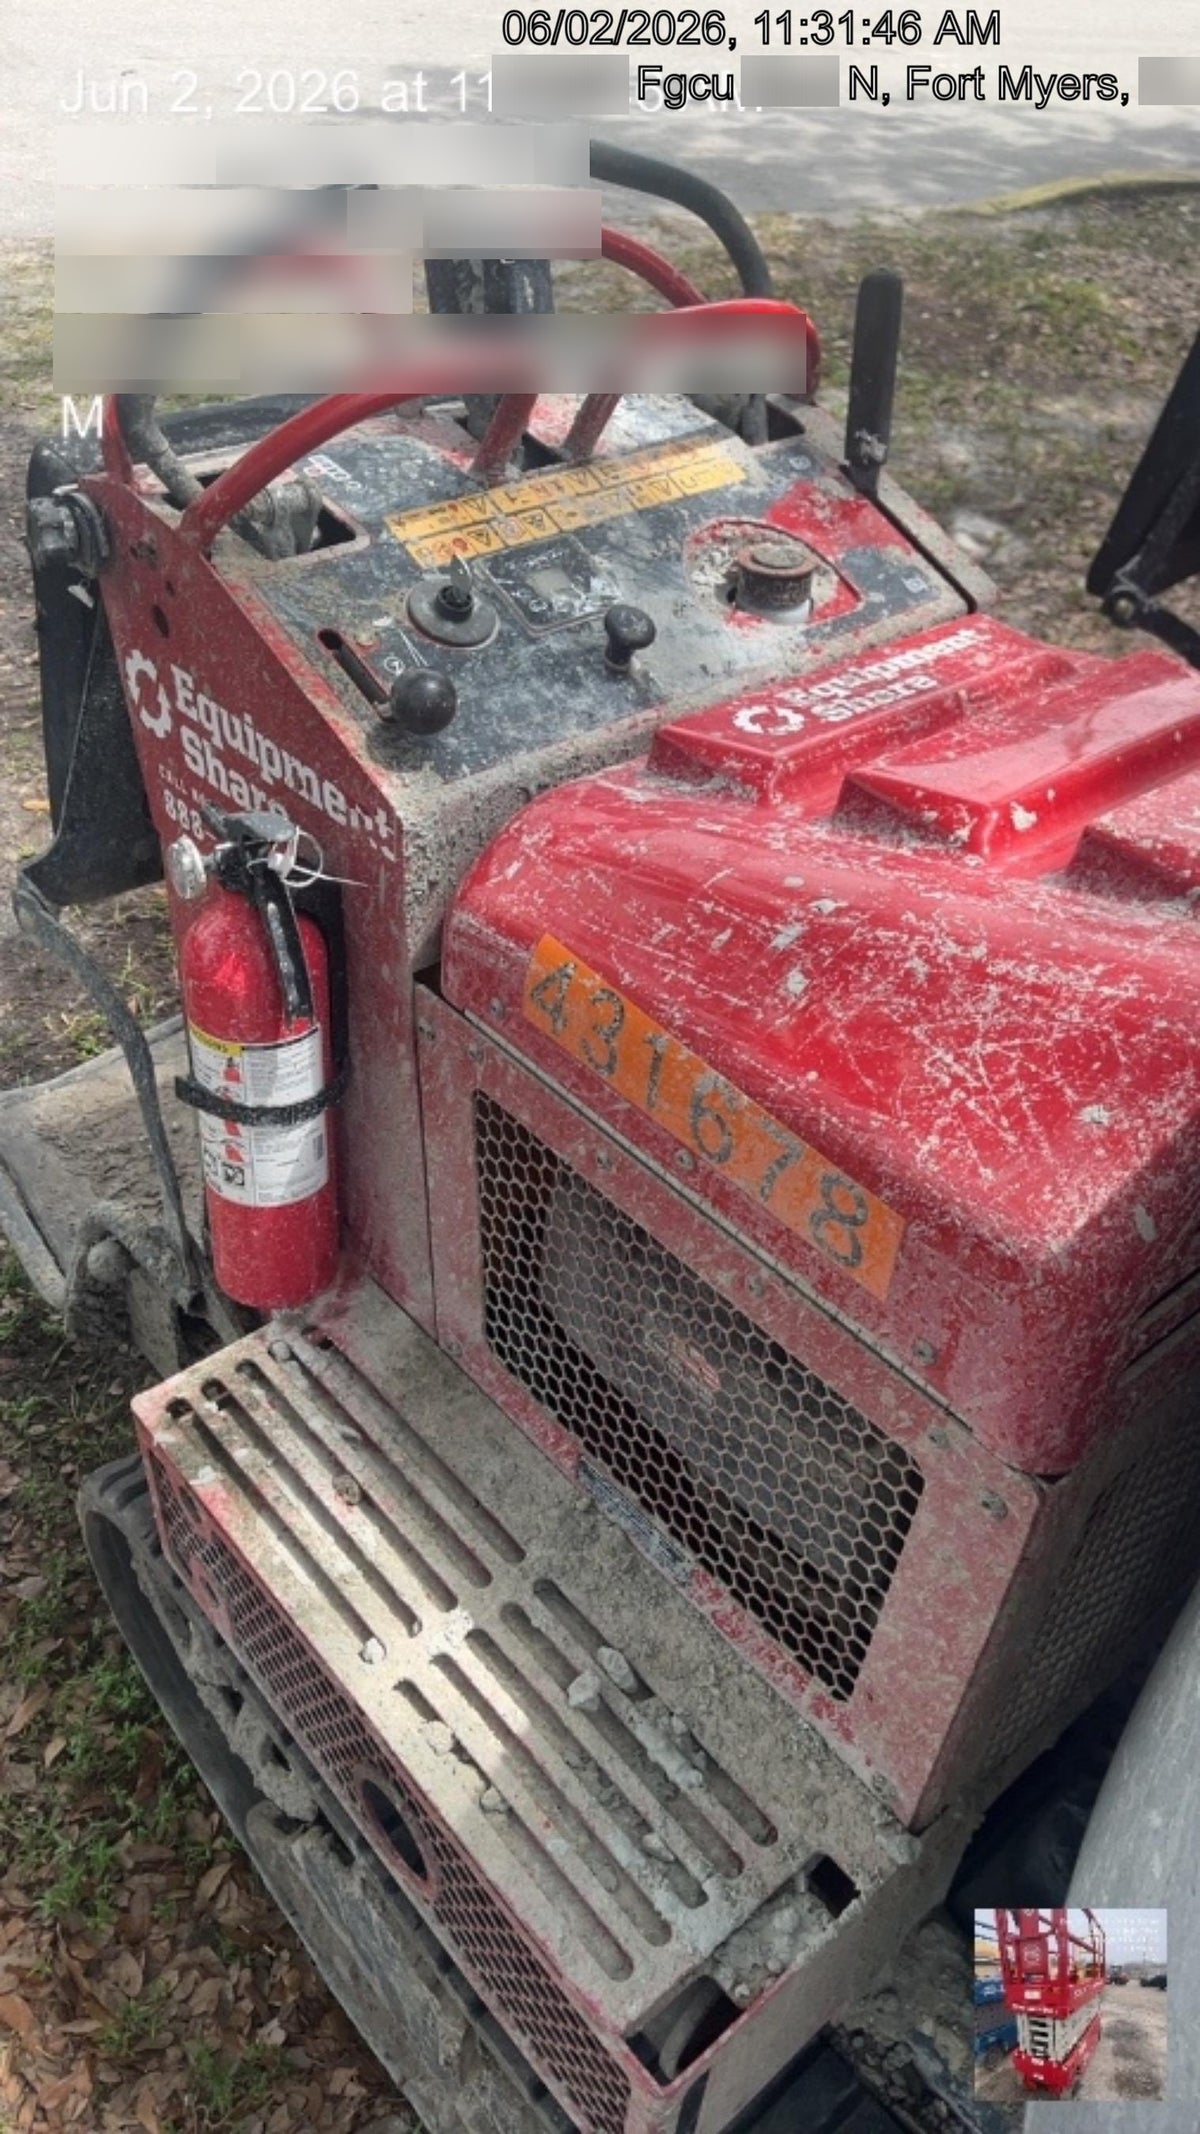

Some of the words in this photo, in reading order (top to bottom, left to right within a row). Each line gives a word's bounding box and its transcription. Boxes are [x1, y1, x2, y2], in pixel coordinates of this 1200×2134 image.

[776, 629, 992, 706] Equipment
[811, 674, 938, 722] Share
[170, 663, 395, 840] Equipment
[180, 725, 290, 824] Share
[531, 961, 868, 1269] 431678
